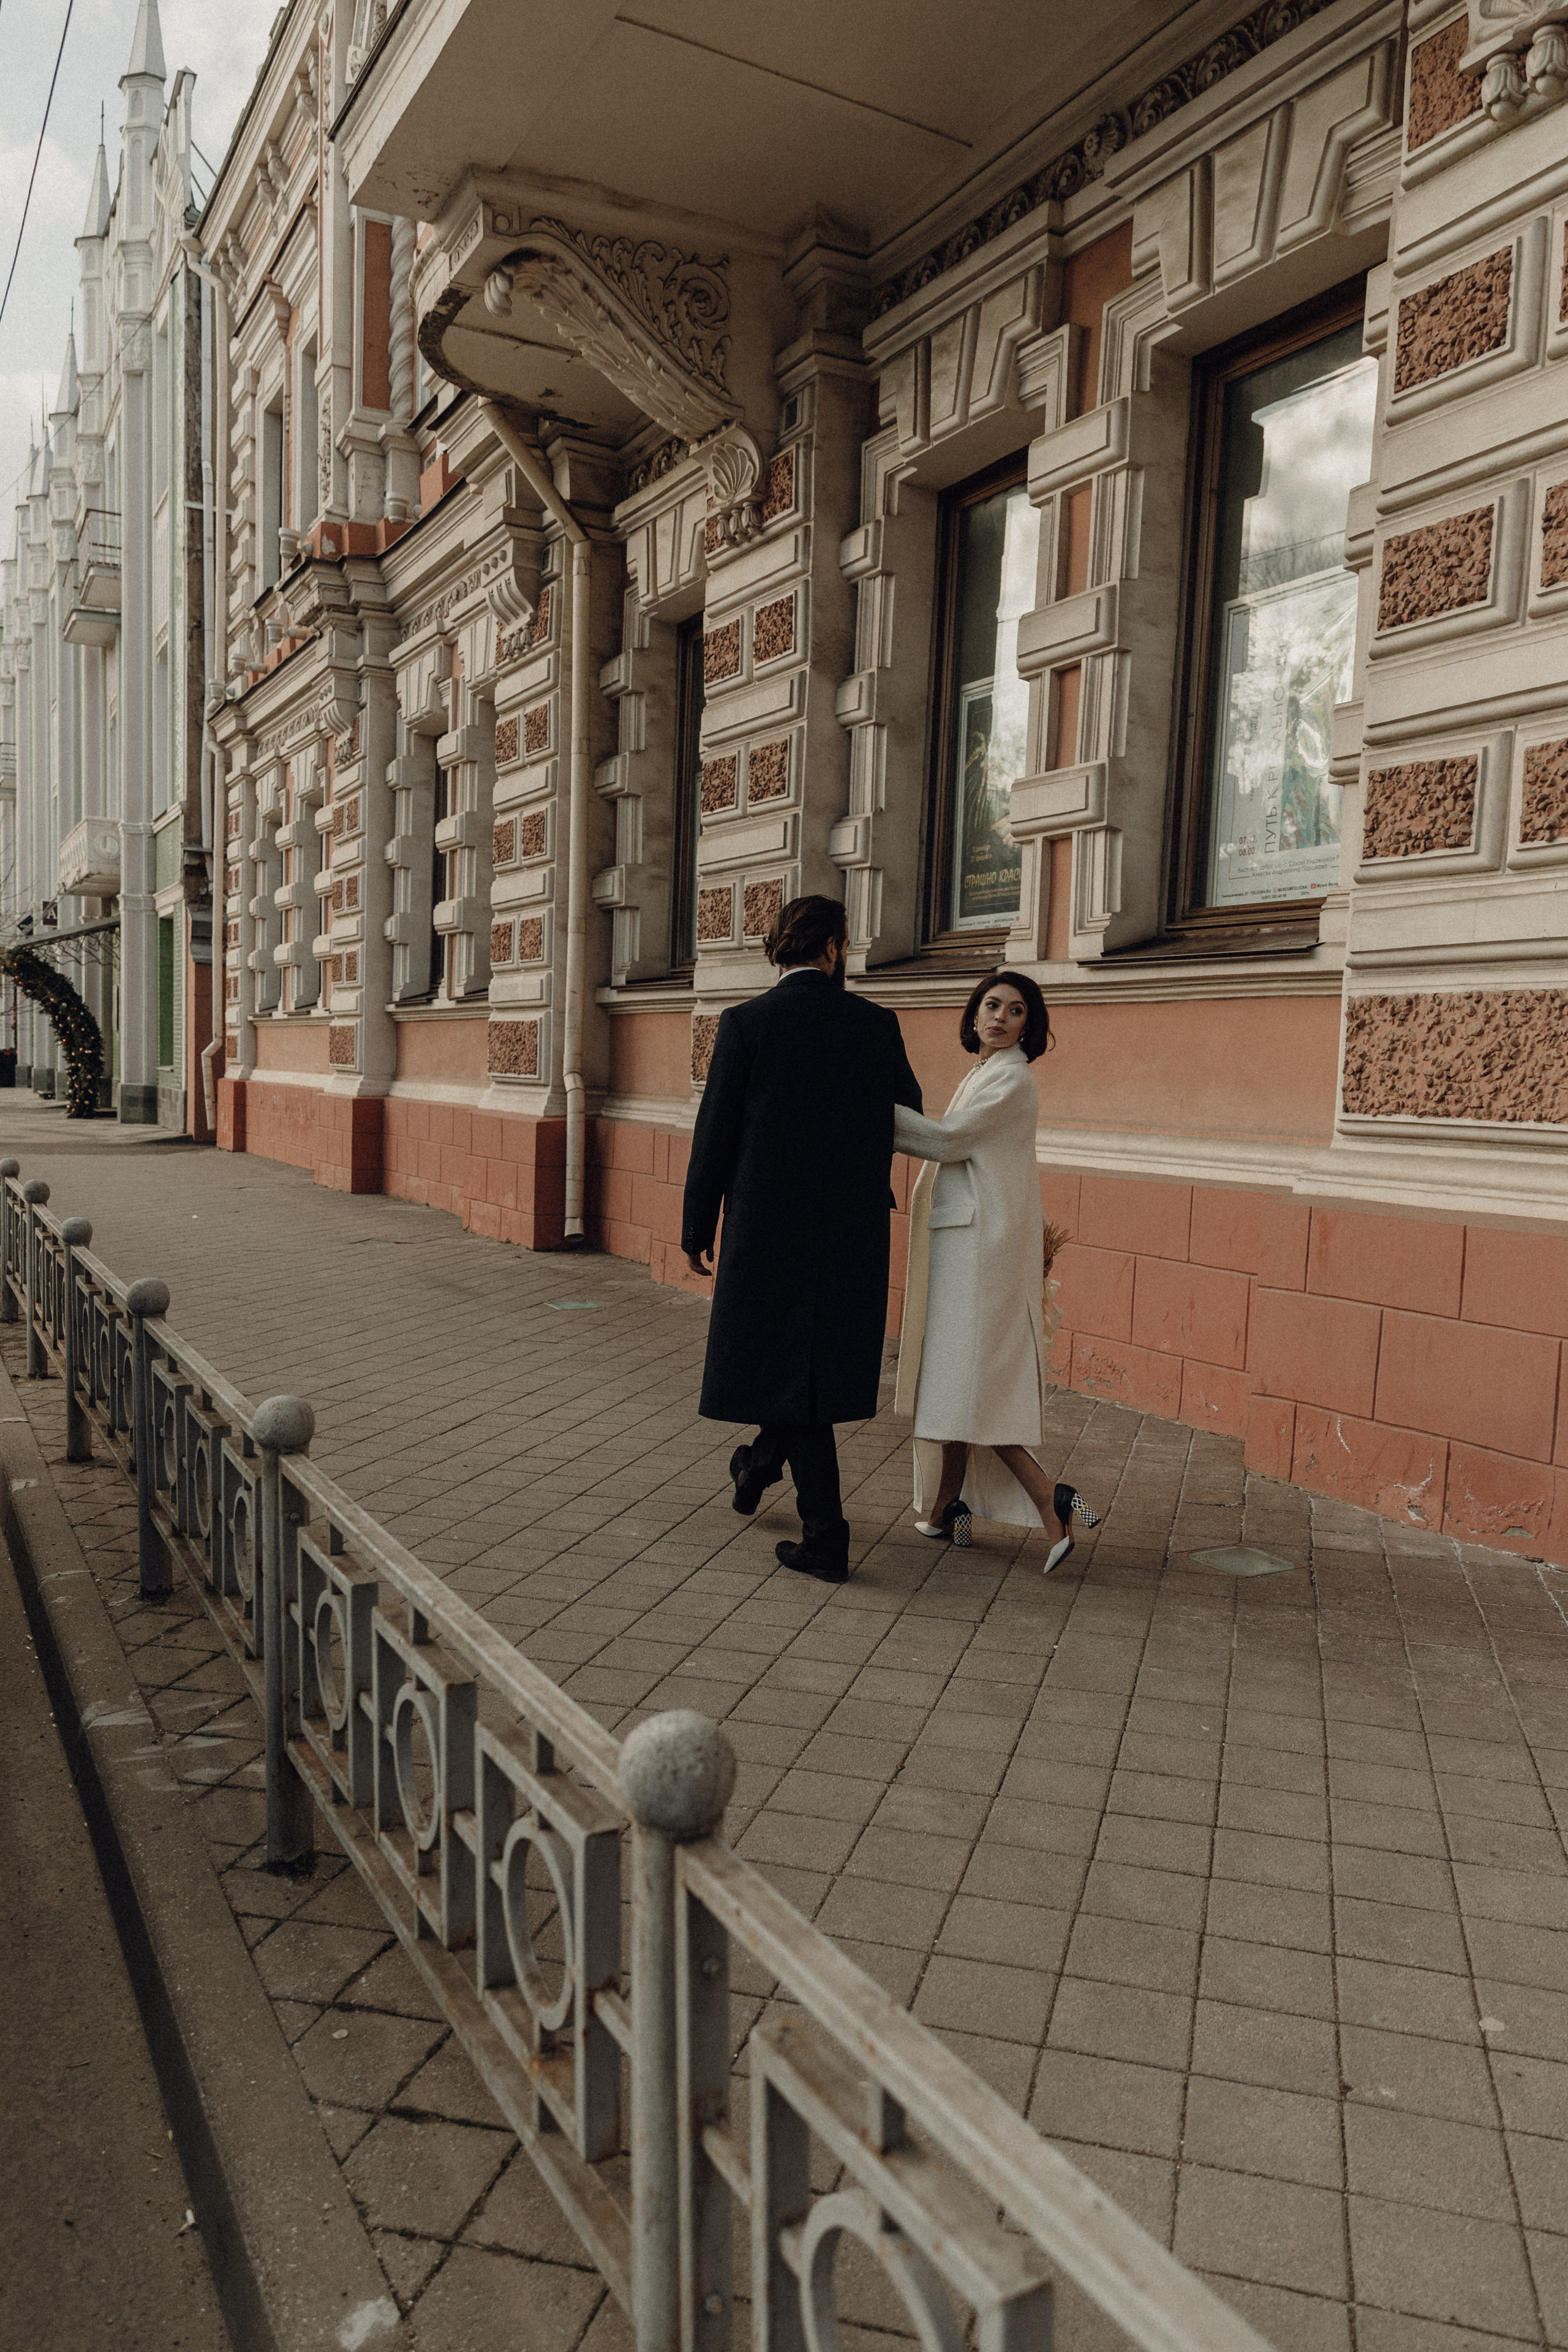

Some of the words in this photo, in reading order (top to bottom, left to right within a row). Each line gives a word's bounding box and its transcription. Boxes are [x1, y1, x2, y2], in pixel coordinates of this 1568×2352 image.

[1267, 788, 1278, 800] К
[1264, 806, 1278, 854] ПУТЬ
[964, 871, 997, 889] СТРАШНО
